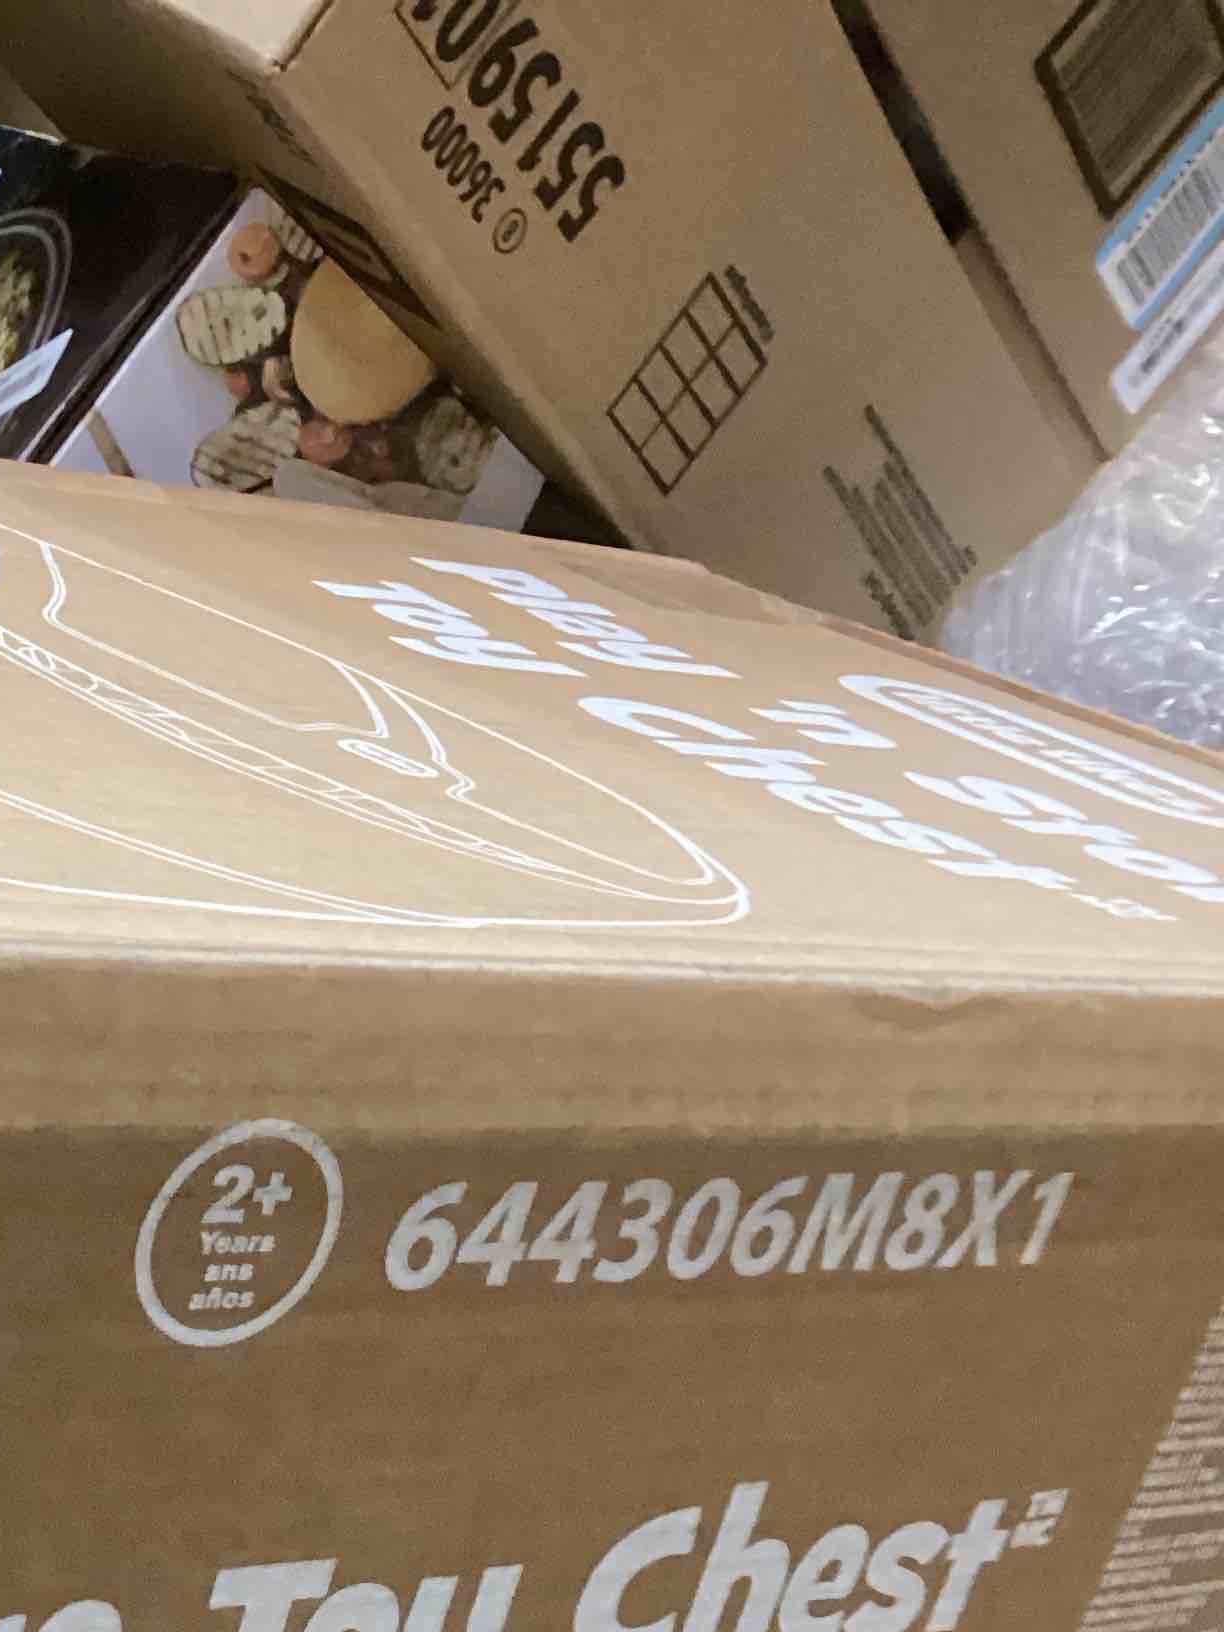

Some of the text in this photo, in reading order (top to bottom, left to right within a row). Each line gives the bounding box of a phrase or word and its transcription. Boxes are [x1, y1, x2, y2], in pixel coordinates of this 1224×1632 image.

[409, 556, 743, 679] Play
[311, 580, 1079, 890] Toy Chest
[201, 1163, 293, 1224] 2+
[201, 1231, 275, 1255] Years
[385, 1171, 1074, 1291] 644306M8X1
